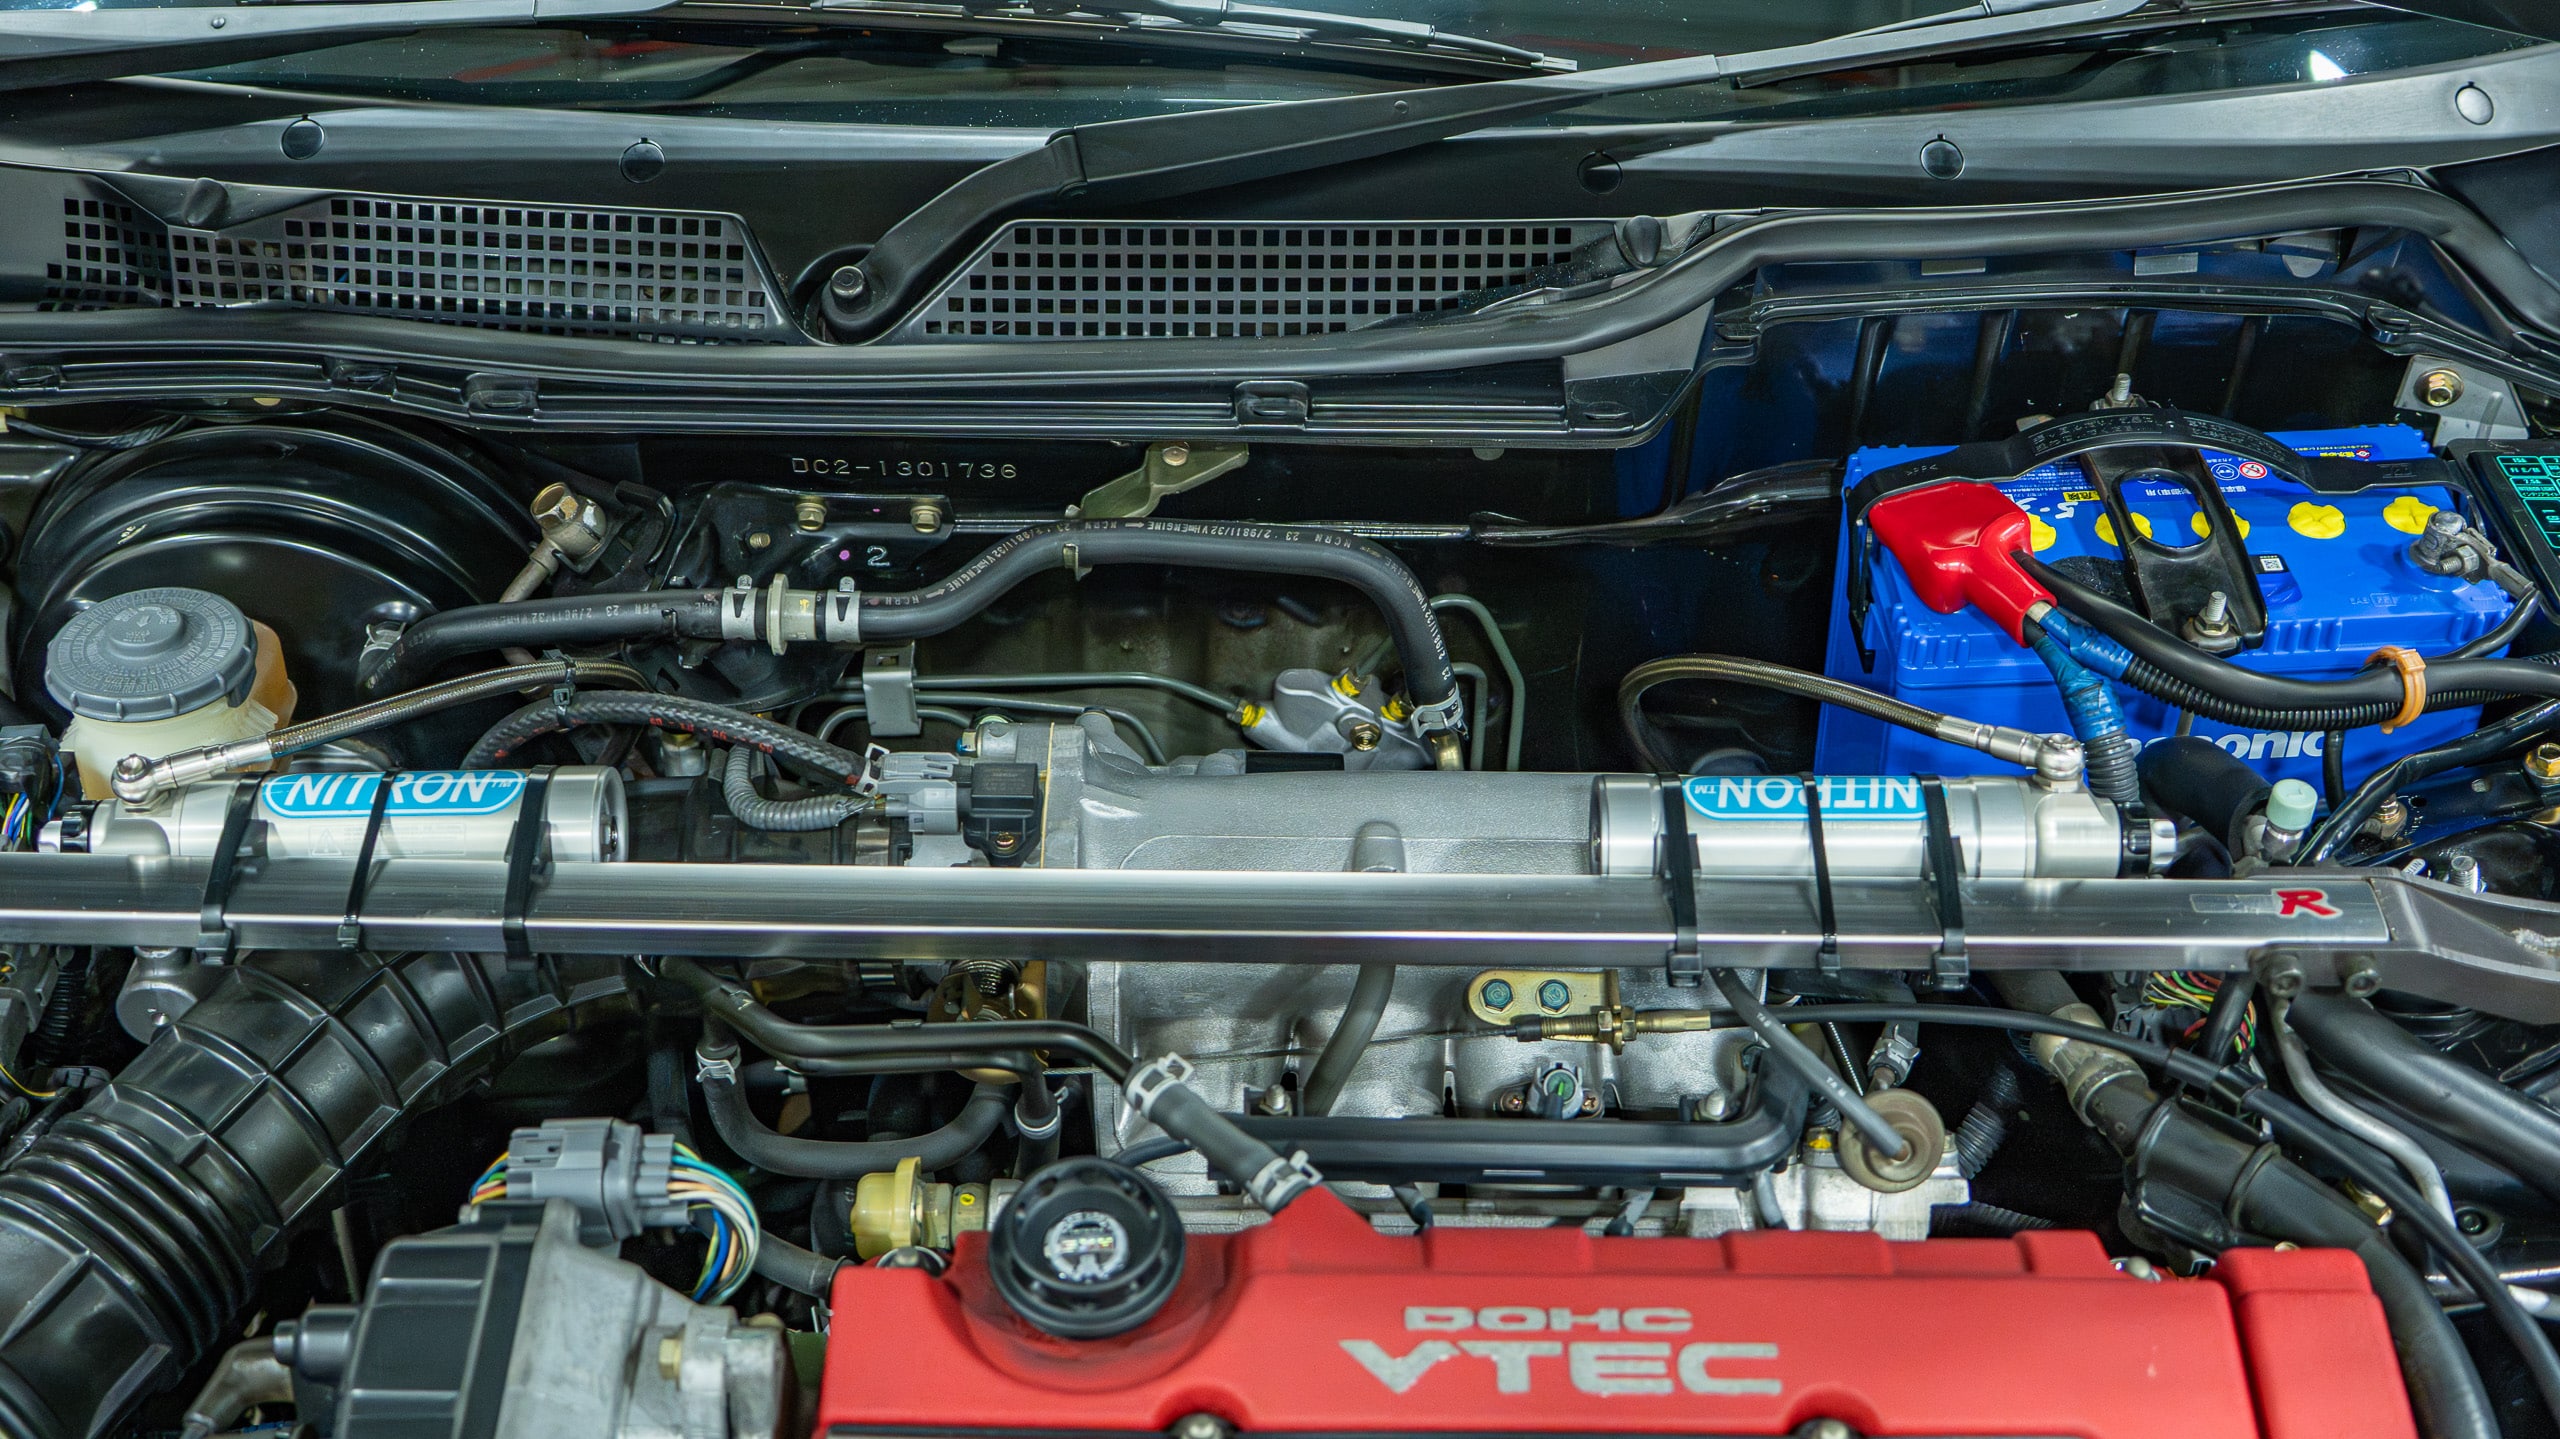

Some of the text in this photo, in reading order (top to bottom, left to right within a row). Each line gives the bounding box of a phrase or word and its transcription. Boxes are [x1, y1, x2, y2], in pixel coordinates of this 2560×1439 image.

[791, 457, 1017, 479] DC2-1301736
[866, 544, 890, 567] 2
[284, 771, 496, 806] NITRON
[1717, 777, 1918, 809] NITRON
[2272, 888, 2344, 918] R
[1403, 1306, 1693, 1332] DOHC
[1338, 1339, 1783, 1397] VTEC
